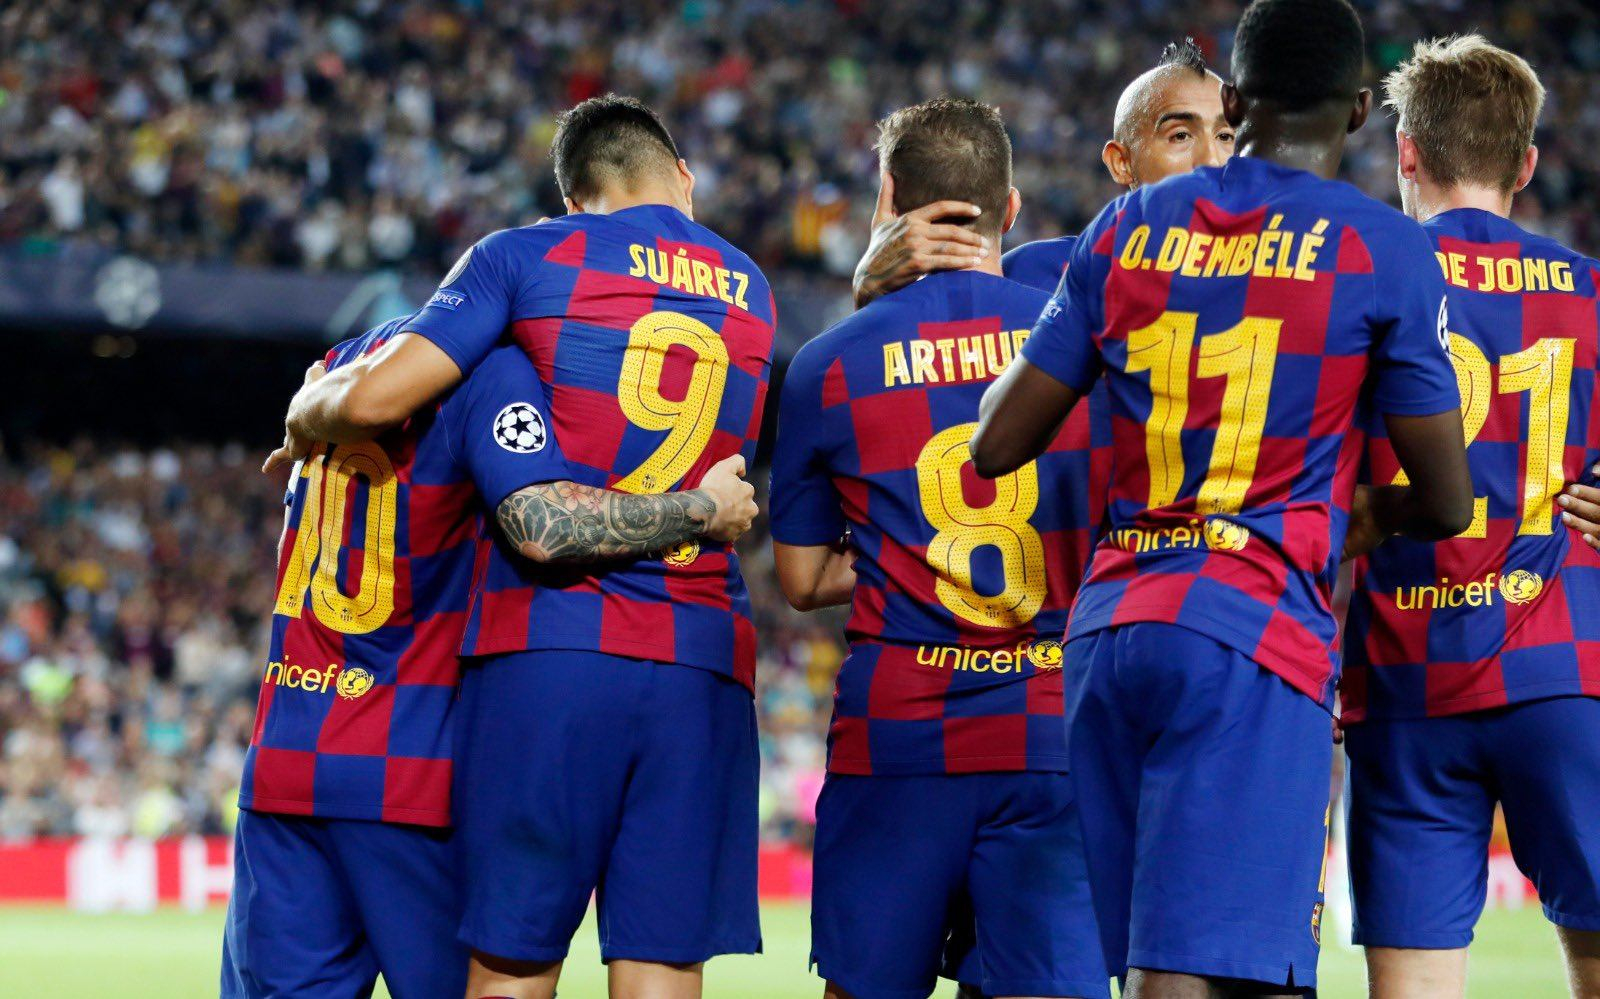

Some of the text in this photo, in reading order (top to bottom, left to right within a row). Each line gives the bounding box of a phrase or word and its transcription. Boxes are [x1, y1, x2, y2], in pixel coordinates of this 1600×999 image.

[629, 244, 749, 311] SUÁREZ
[1119, 214, 1330, 281] O.DEMBÉLÉ
[1477, 256, 1575, 293] JONG
[430, 292, 464, 306] SPECT
[612, 311, 730, 495] 9
[1124, 311, 1284, 515] 11
[273, 441, 398, 634] 10
[915, 421, 1048, 628] 8
[1396, 572, 1496, 611] unicef
[264, 654, 338, 694] nicef
[916, 642, 1028, 674] unicef
